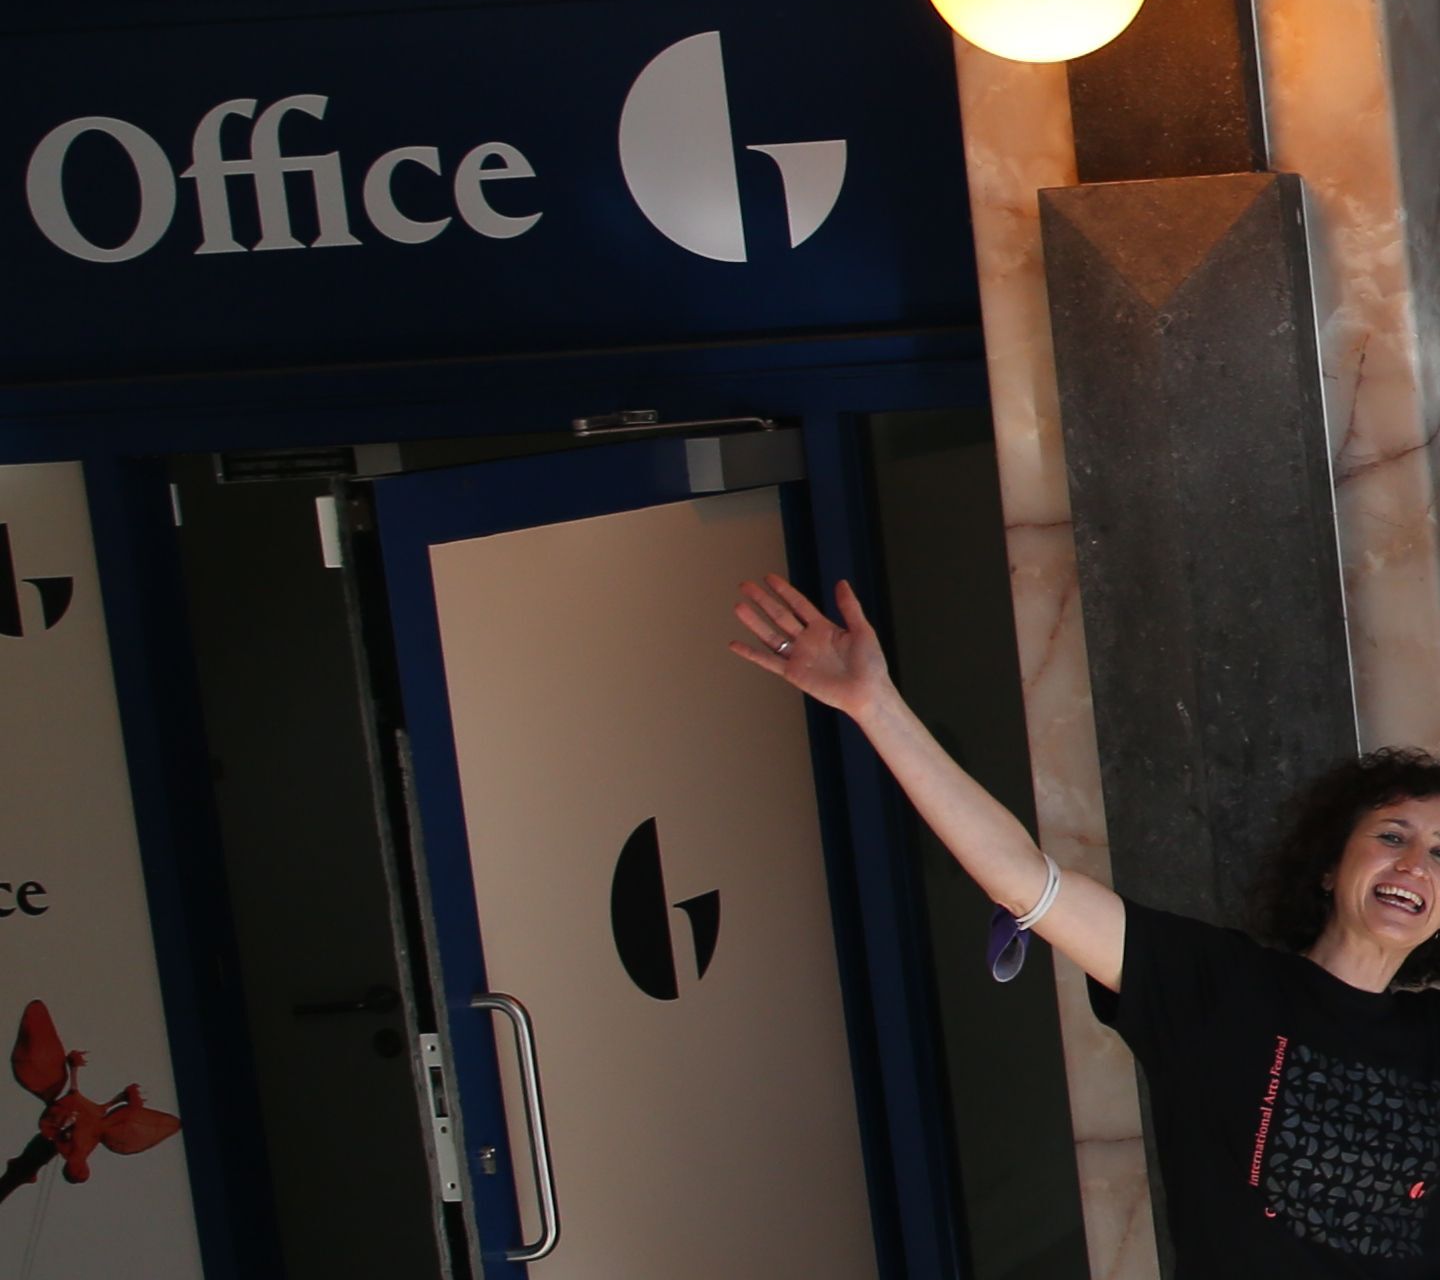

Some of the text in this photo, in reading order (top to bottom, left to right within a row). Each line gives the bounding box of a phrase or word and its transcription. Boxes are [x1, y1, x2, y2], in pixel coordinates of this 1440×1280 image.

[26, 93, 543, 263] Office
[1270, 1035, 1288, 1077] Festival
[1263, 1077, 1281, 1105] Arts
